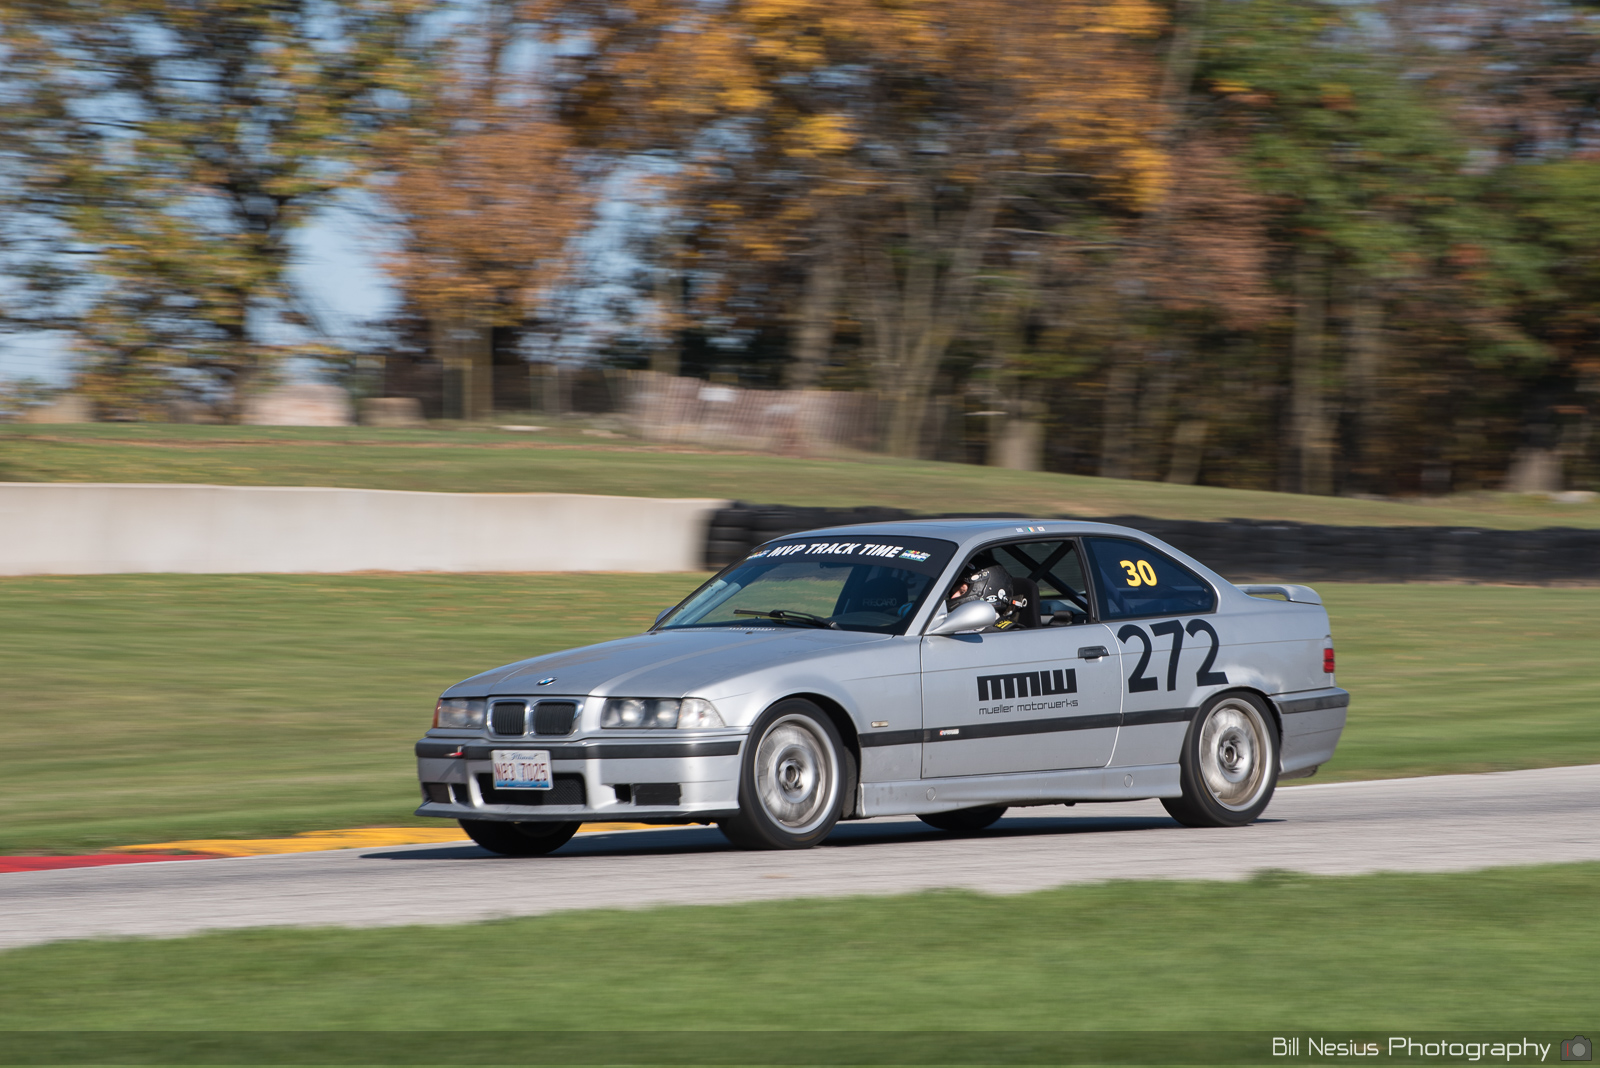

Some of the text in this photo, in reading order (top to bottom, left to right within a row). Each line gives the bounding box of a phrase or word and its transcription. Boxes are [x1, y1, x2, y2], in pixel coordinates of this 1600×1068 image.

[766, 544, 807, 558] MVP
[804, 542, 862, 555] TRACK
[858, 543, 904, 558] TIME
[1119, 559, 1158, 587] 30
[862, 597, 897, 607] RECARO
[1117, 618, 1229, 694] 272
[978, 698, 1079, 715] mueller motorwerks
[519, 762, 549, 782] 7025
